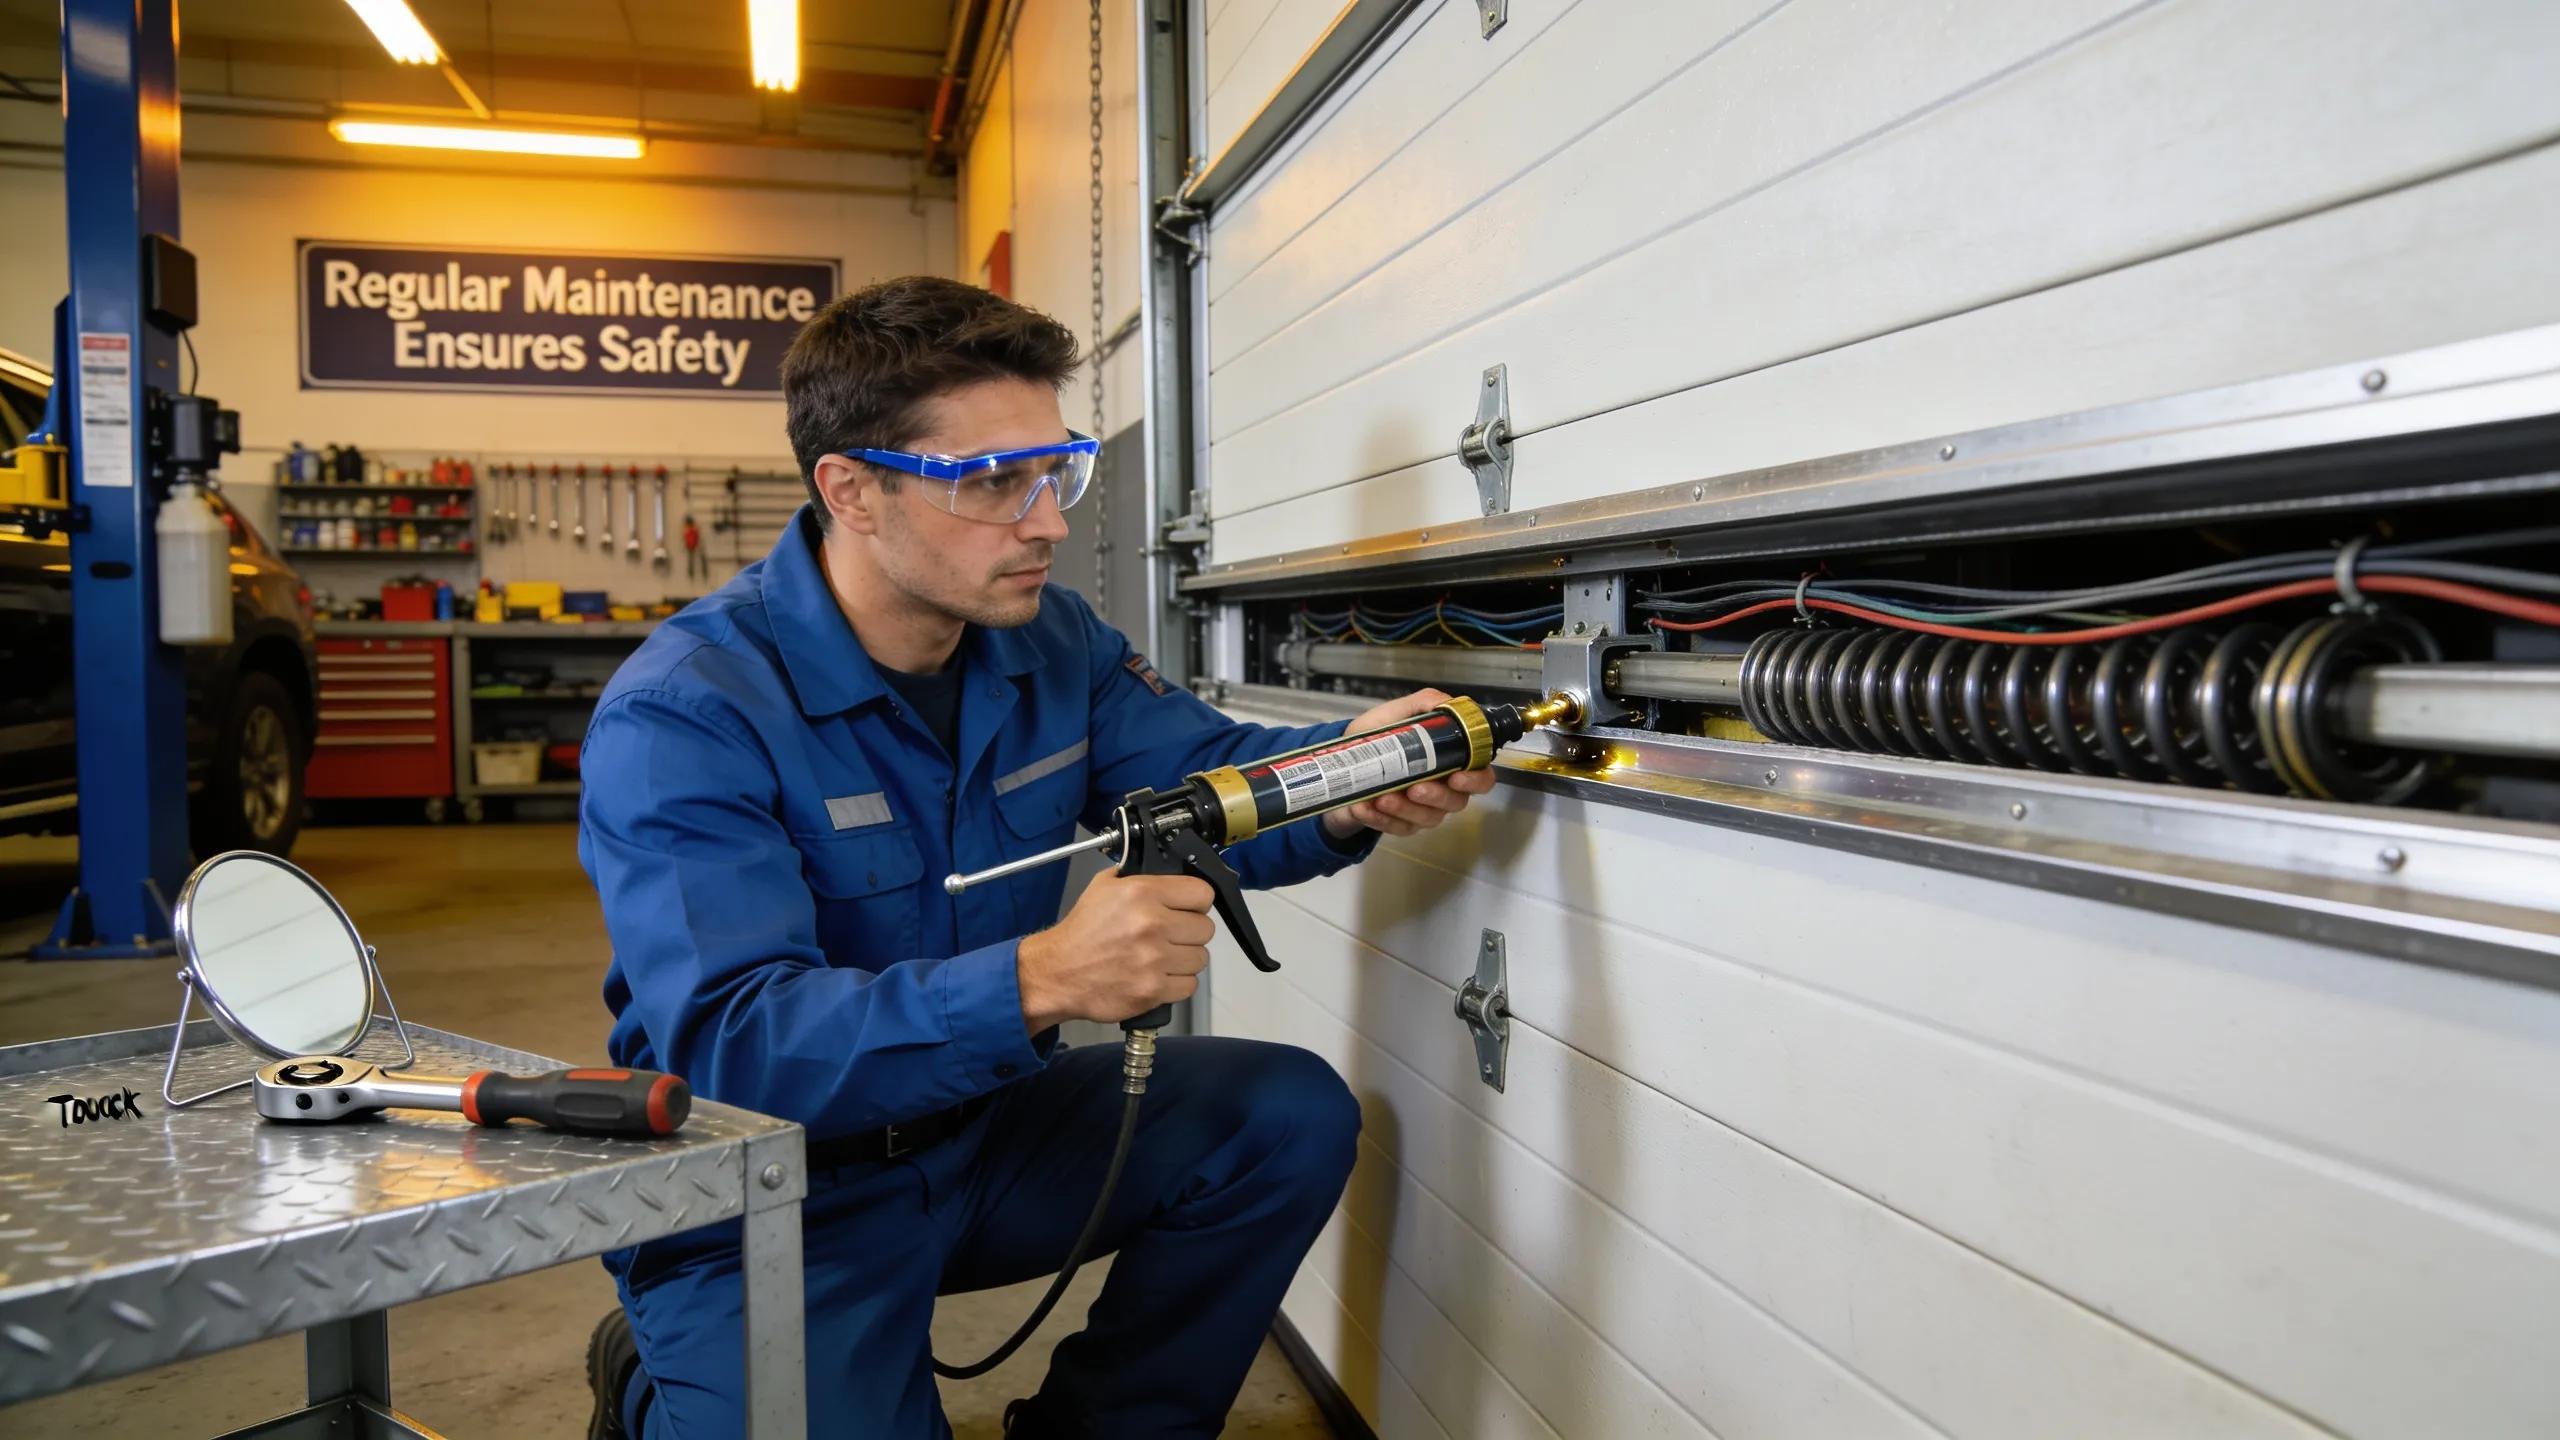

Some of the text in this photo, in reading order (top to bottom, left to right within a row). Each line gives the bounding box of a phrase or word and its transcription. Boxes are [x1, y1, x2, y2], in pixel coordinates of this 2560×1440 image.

[324, 261, 814, 321] Regular Maintenance
[394, 321, 750, 386] Ensures Safety
